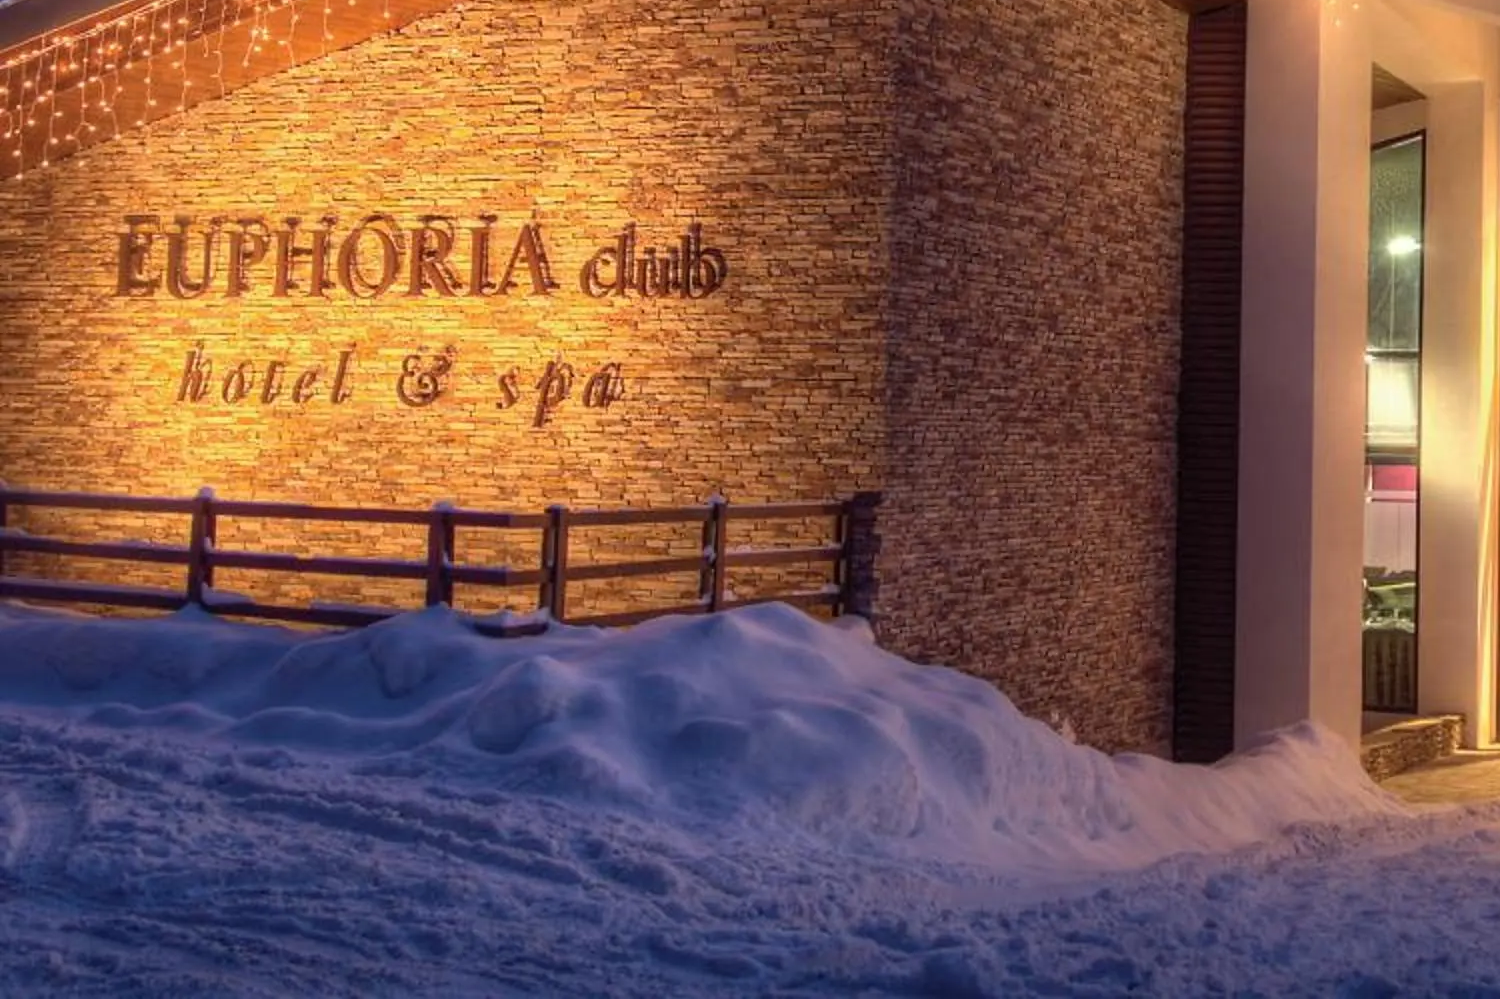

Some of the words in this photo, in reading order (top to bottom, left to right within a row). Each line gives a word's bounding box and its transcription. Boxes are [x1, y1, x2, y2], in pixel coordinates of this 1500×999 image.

[114, 216, 557, 300] EUPHORIA
[579, 225, 725, 300] club
[177, 346, 354, 404] hotel
[397, 350, 452, 406] &
[497, 359, 622, 427] spa
